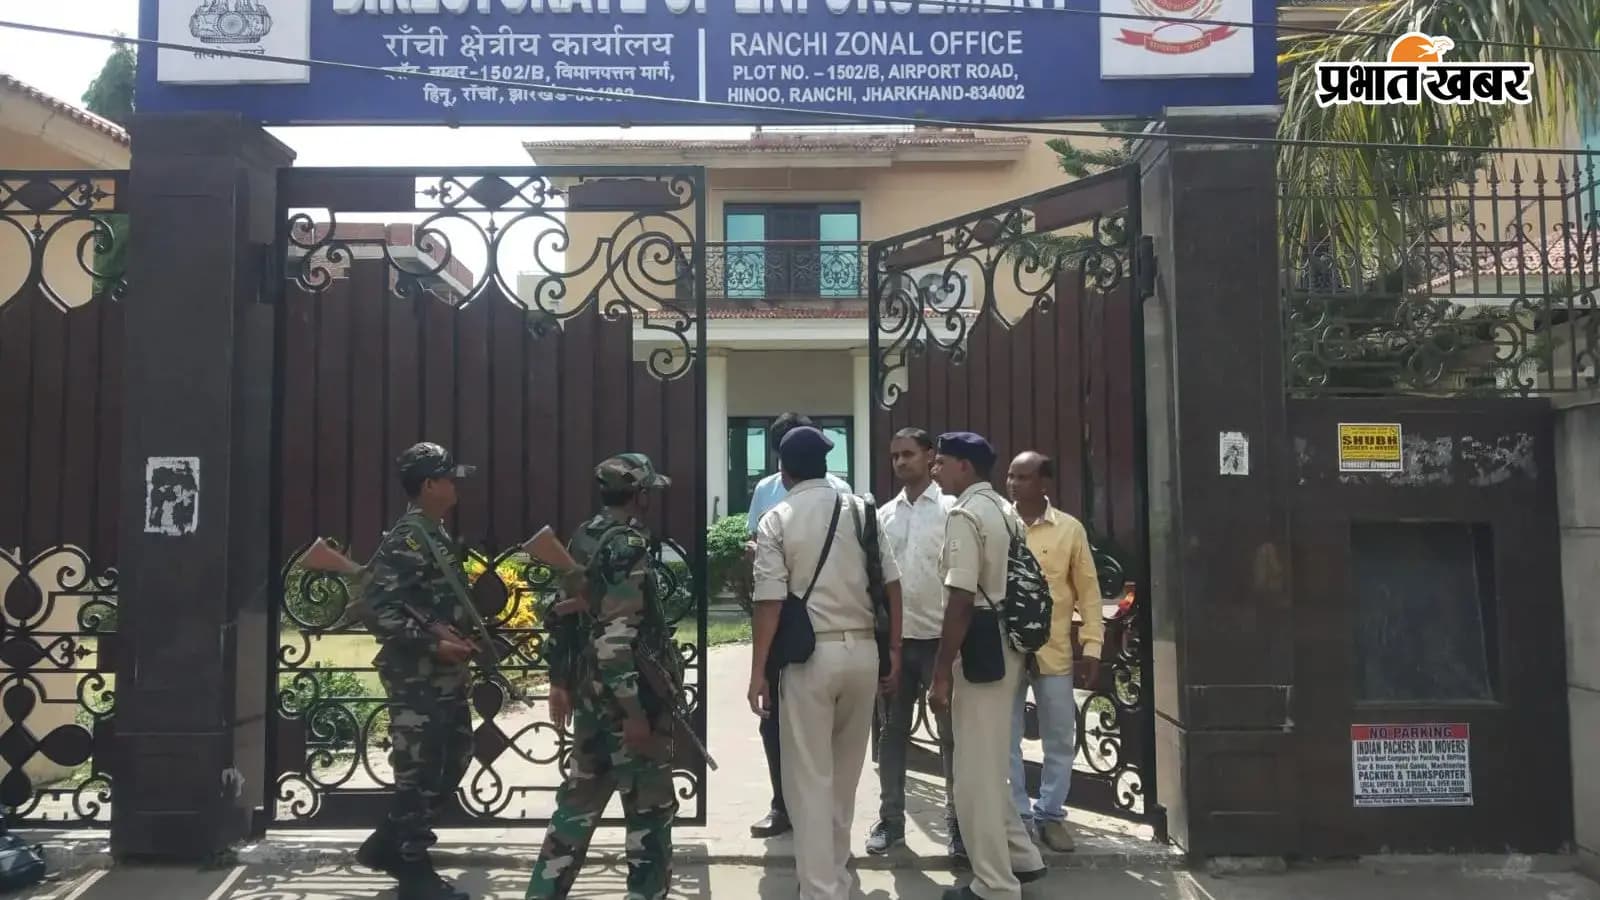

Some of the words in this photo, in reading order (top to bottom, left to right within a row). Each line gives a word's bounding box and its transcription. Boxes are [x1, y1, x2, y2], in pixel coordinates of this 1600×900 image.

[383, 25, 448, 57] राँची
[460, 25, 541, 63] क्षेत्रीय
[549, 24, 674, 57] कार्यालय
[730, 32, 827, 57] RANCHI
[835, 32, 923, 56] ZONAL
[930, 30, 1023, 55] OFFICE
[639, 61, 676, 82] मार्ग,
[733, 64, 776, 80] PLOT
[780, 64, 809, 80] NO.
[888, 64, 961, 80] AIRPORT
[966, 63, 1019, 81] ROAD,
[728, 87, 785, 104] HINOO,
[789, 86, 857, 103] RANCHI,
[862, 84, 1025, 103] JHARKHAND-834002
[1342, 435, 1398, 446] SHUBH
[1370, 727, 1388, 739] NO
[1393, 726, 1453, 739] PARKING
[1357, 740, 1382, 755] INDIAN
[1383, 740, 1417, 754] PACKERS
[1418, 740, 1433, 754] AND
[1434, 739, 1466, 754] MOVERS
[1358, 770, 1394, 781] PACKING
[1406, 769, 1466, 780] TRANSPORTER
